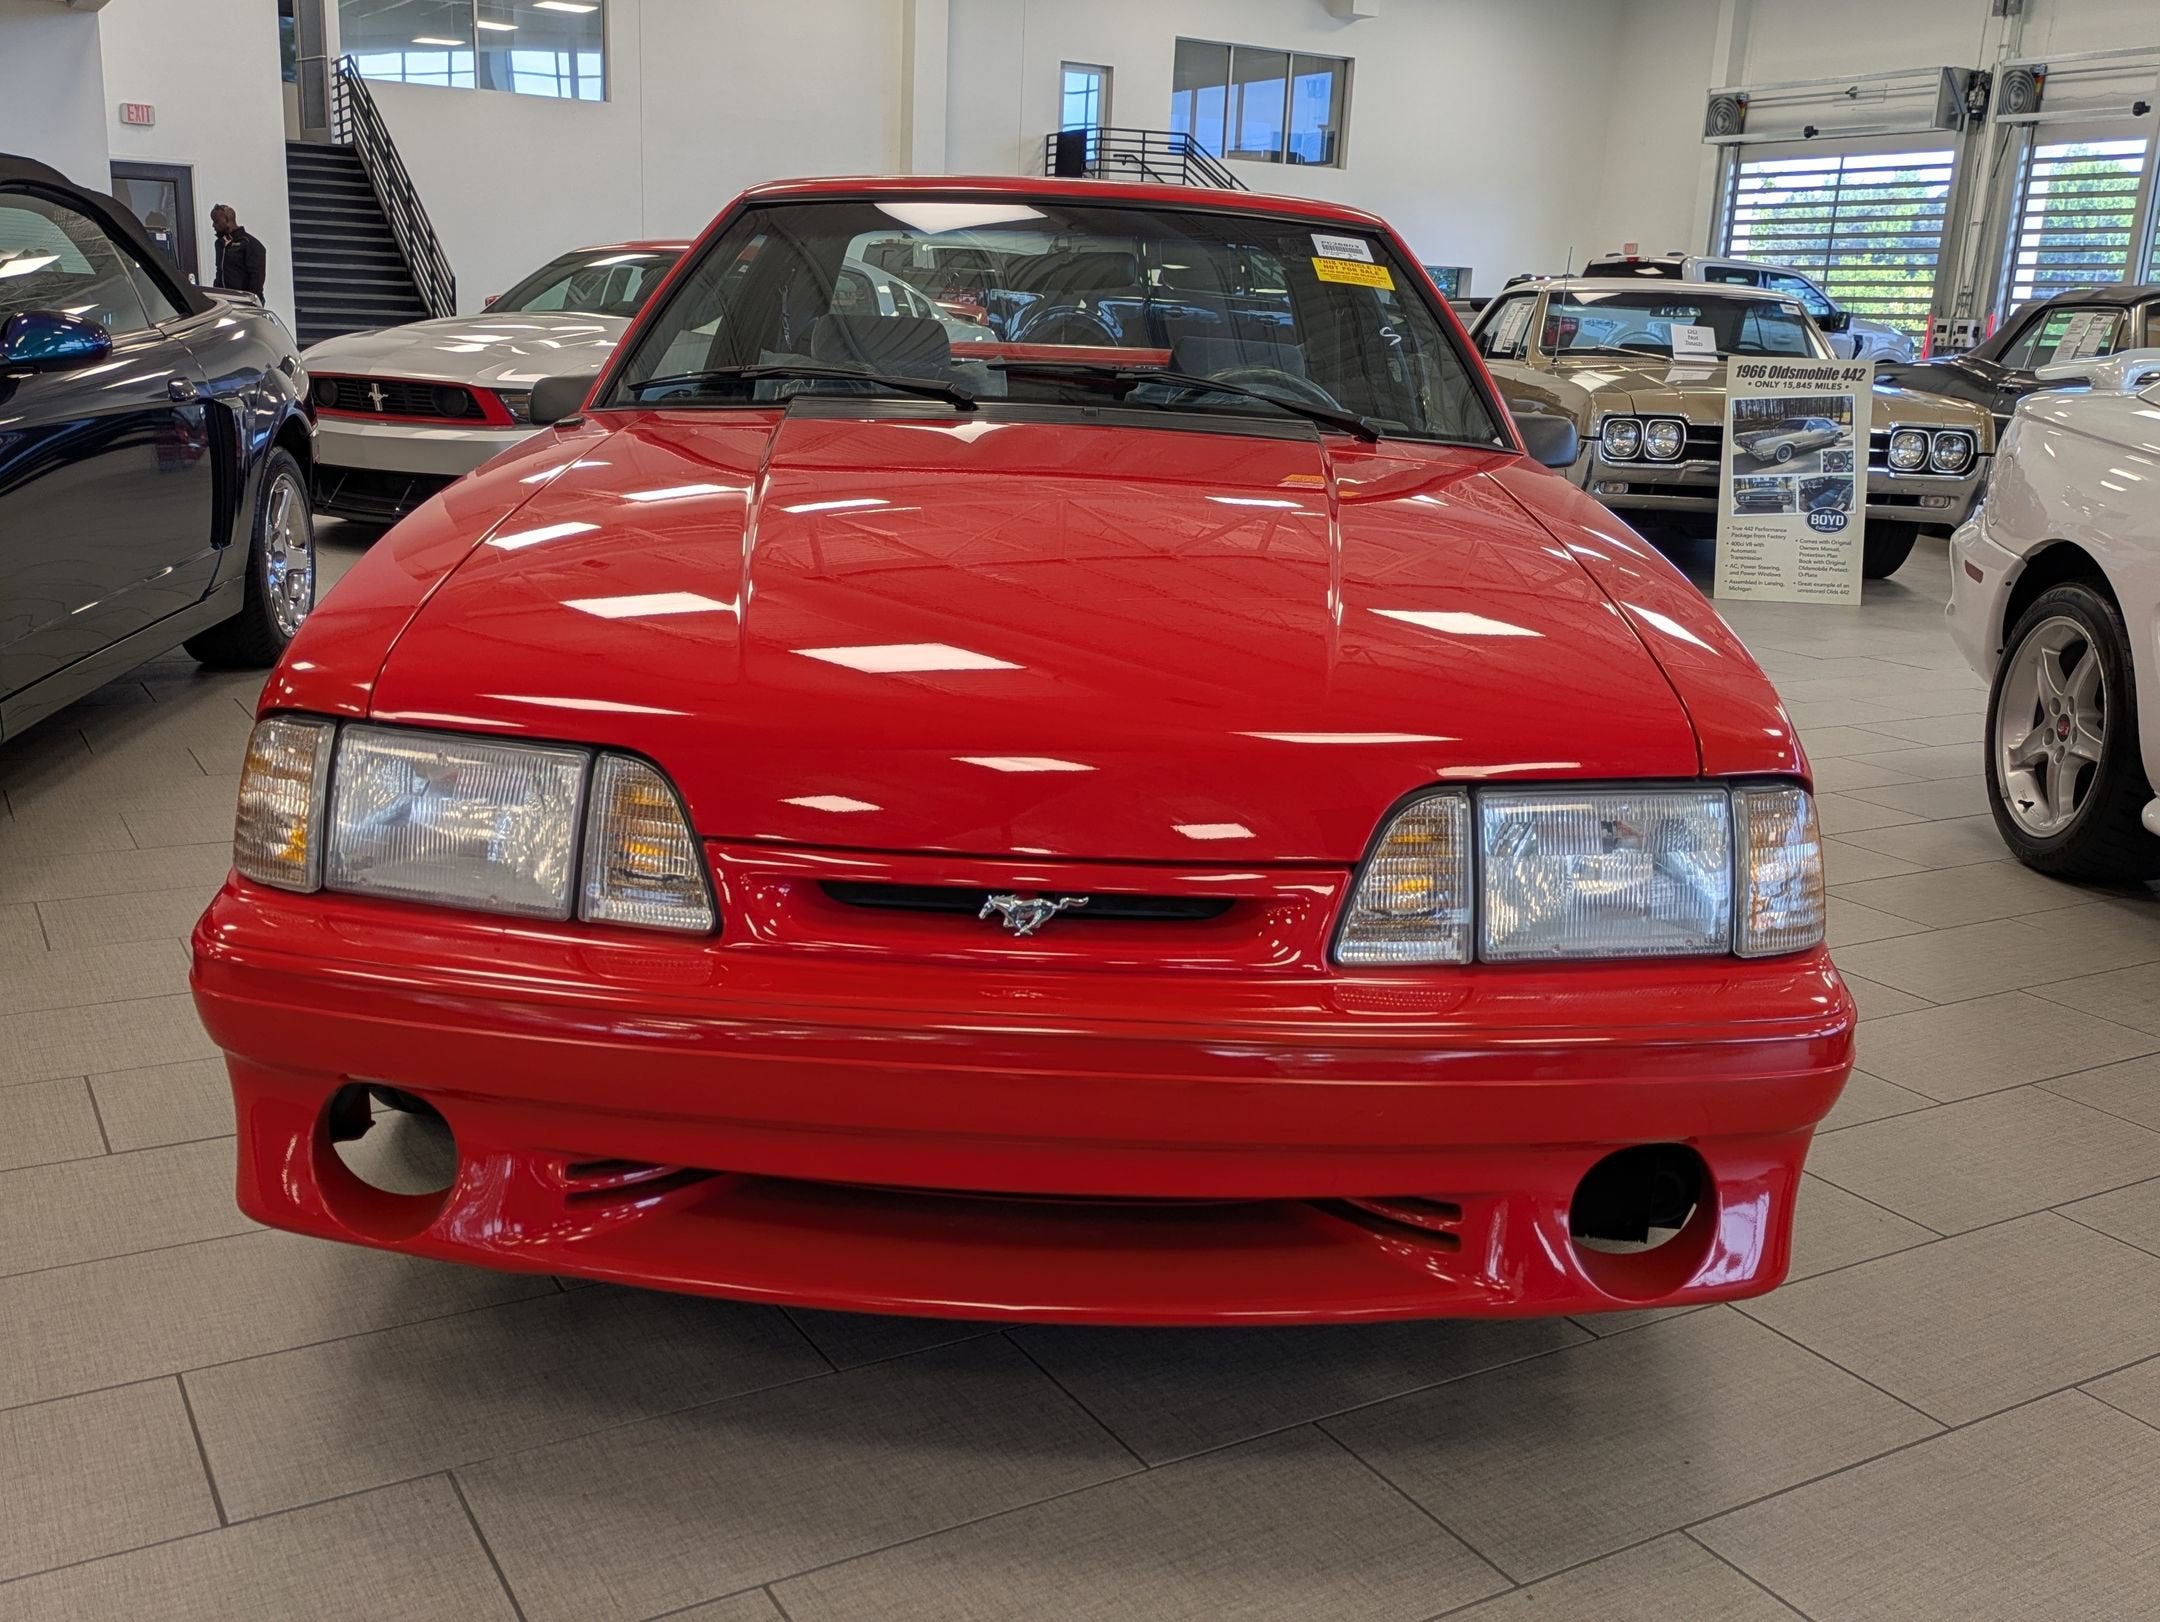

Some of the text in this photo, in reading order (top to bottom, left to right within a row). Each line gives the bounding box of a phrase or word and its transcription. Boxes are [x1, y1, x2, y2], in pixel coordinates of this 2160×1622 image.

[127, 104, 151, 123] EXIT
[1338, 261, 1371, 270] VEHICLE
[1360, 268, 1379, 276] SALE
[1736, 364, 1867, 382] 1966 Oldsmobile 442
[1754, 380, 1842, 390] ONLY 15,845 MILES
[1810, 514, 1845, 526] BOYD
